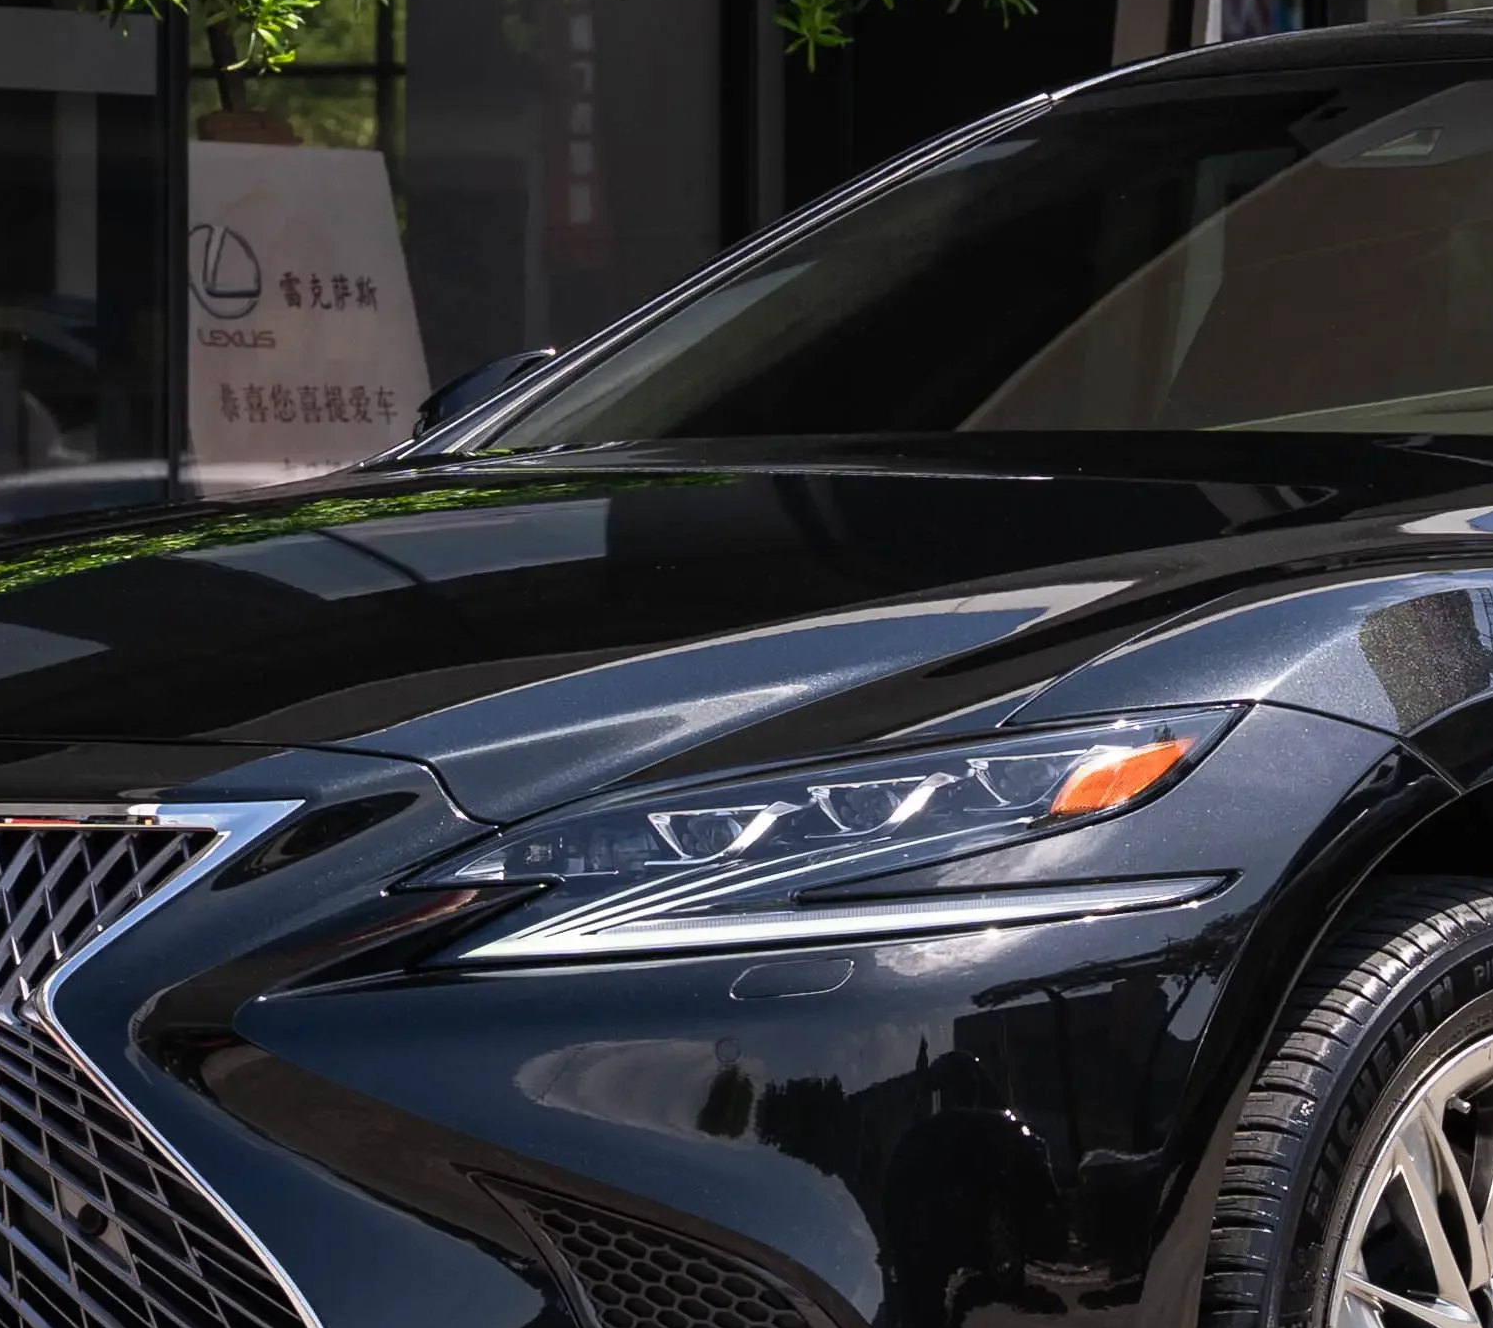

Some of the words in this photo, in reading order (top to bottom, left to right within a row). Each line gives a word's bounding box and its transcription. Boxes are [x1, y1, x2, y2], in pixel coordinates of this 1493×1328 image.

[279, 271, 378, 312] 雷克萨斯
[197, 328, 277, 349] LEXUS
[220, 382, 398, 425] 恭喜您喜提爱车
